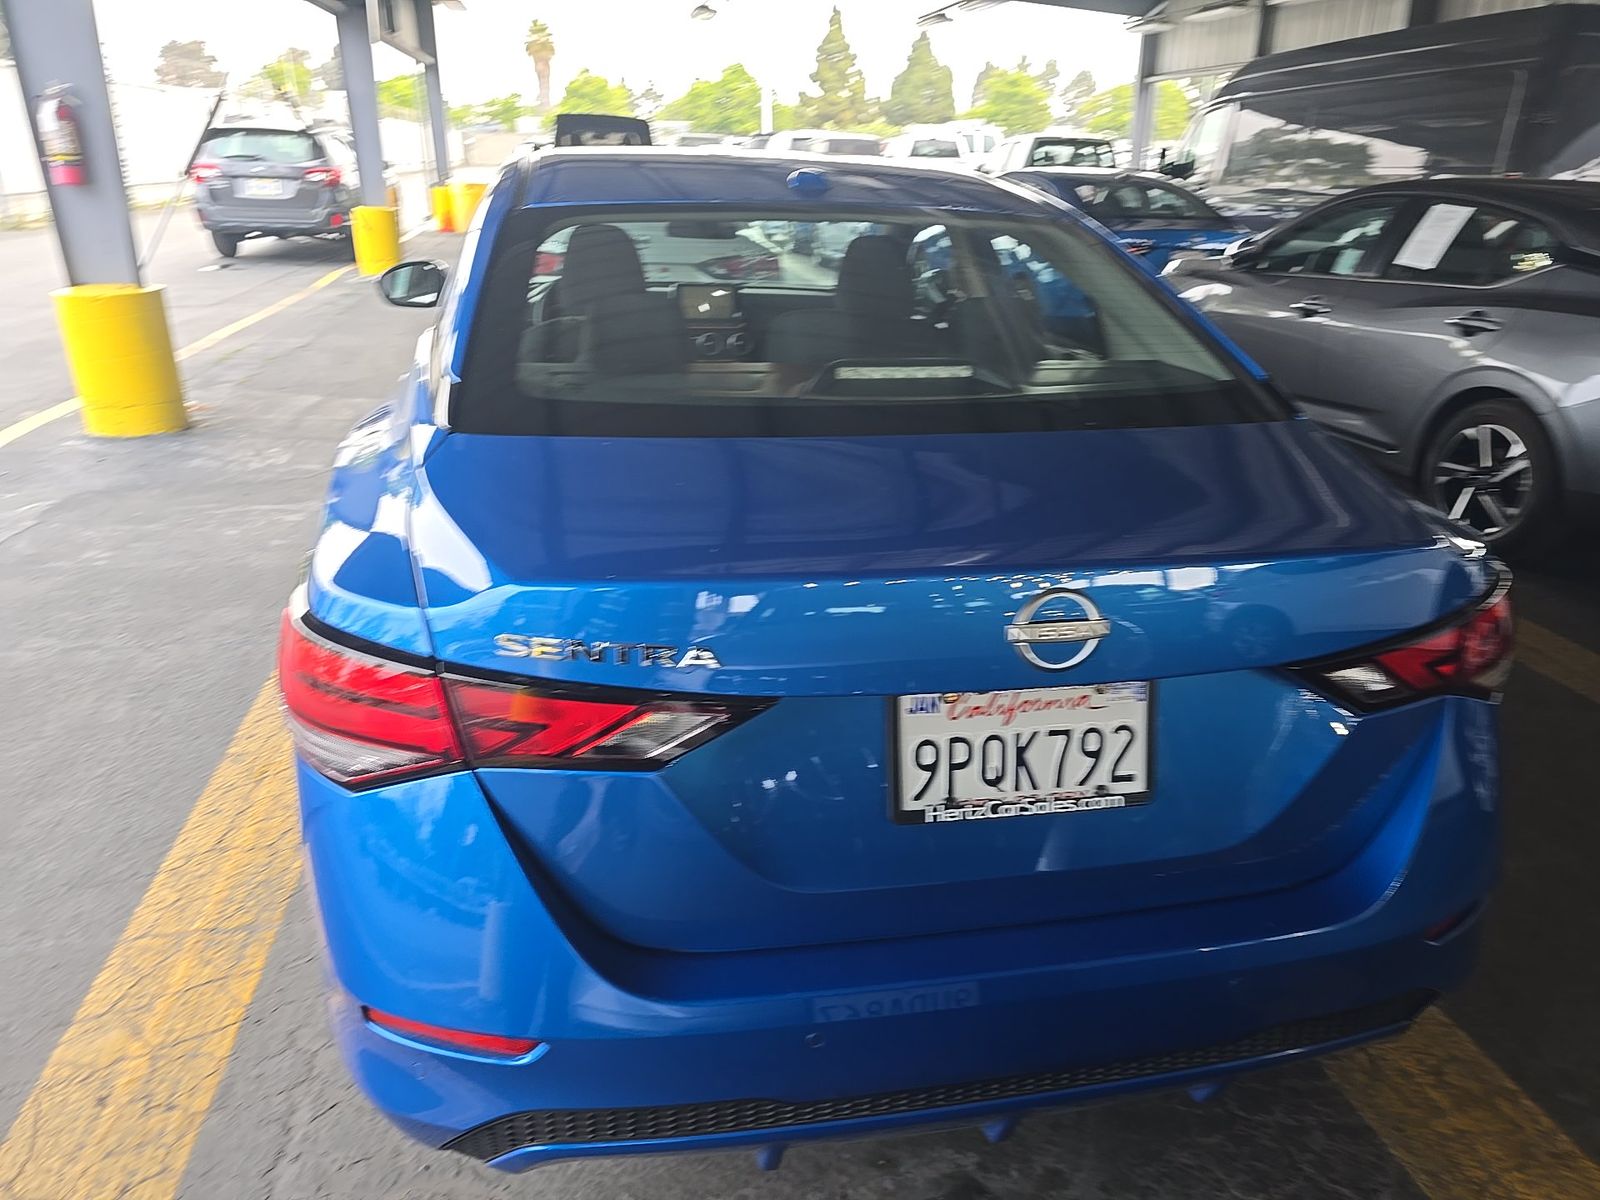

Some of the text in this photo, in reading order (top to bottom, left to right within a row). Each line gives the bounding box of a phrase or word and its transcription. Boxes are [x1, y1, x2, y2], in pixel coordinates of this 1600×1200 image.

[494, 633, 722, 669] SENTRA
[946, 693, 1091, 725] California
[914, 724, 1136, 801] 9PQK792
[924, 795, 1126, 823] HertzCarSales.com
